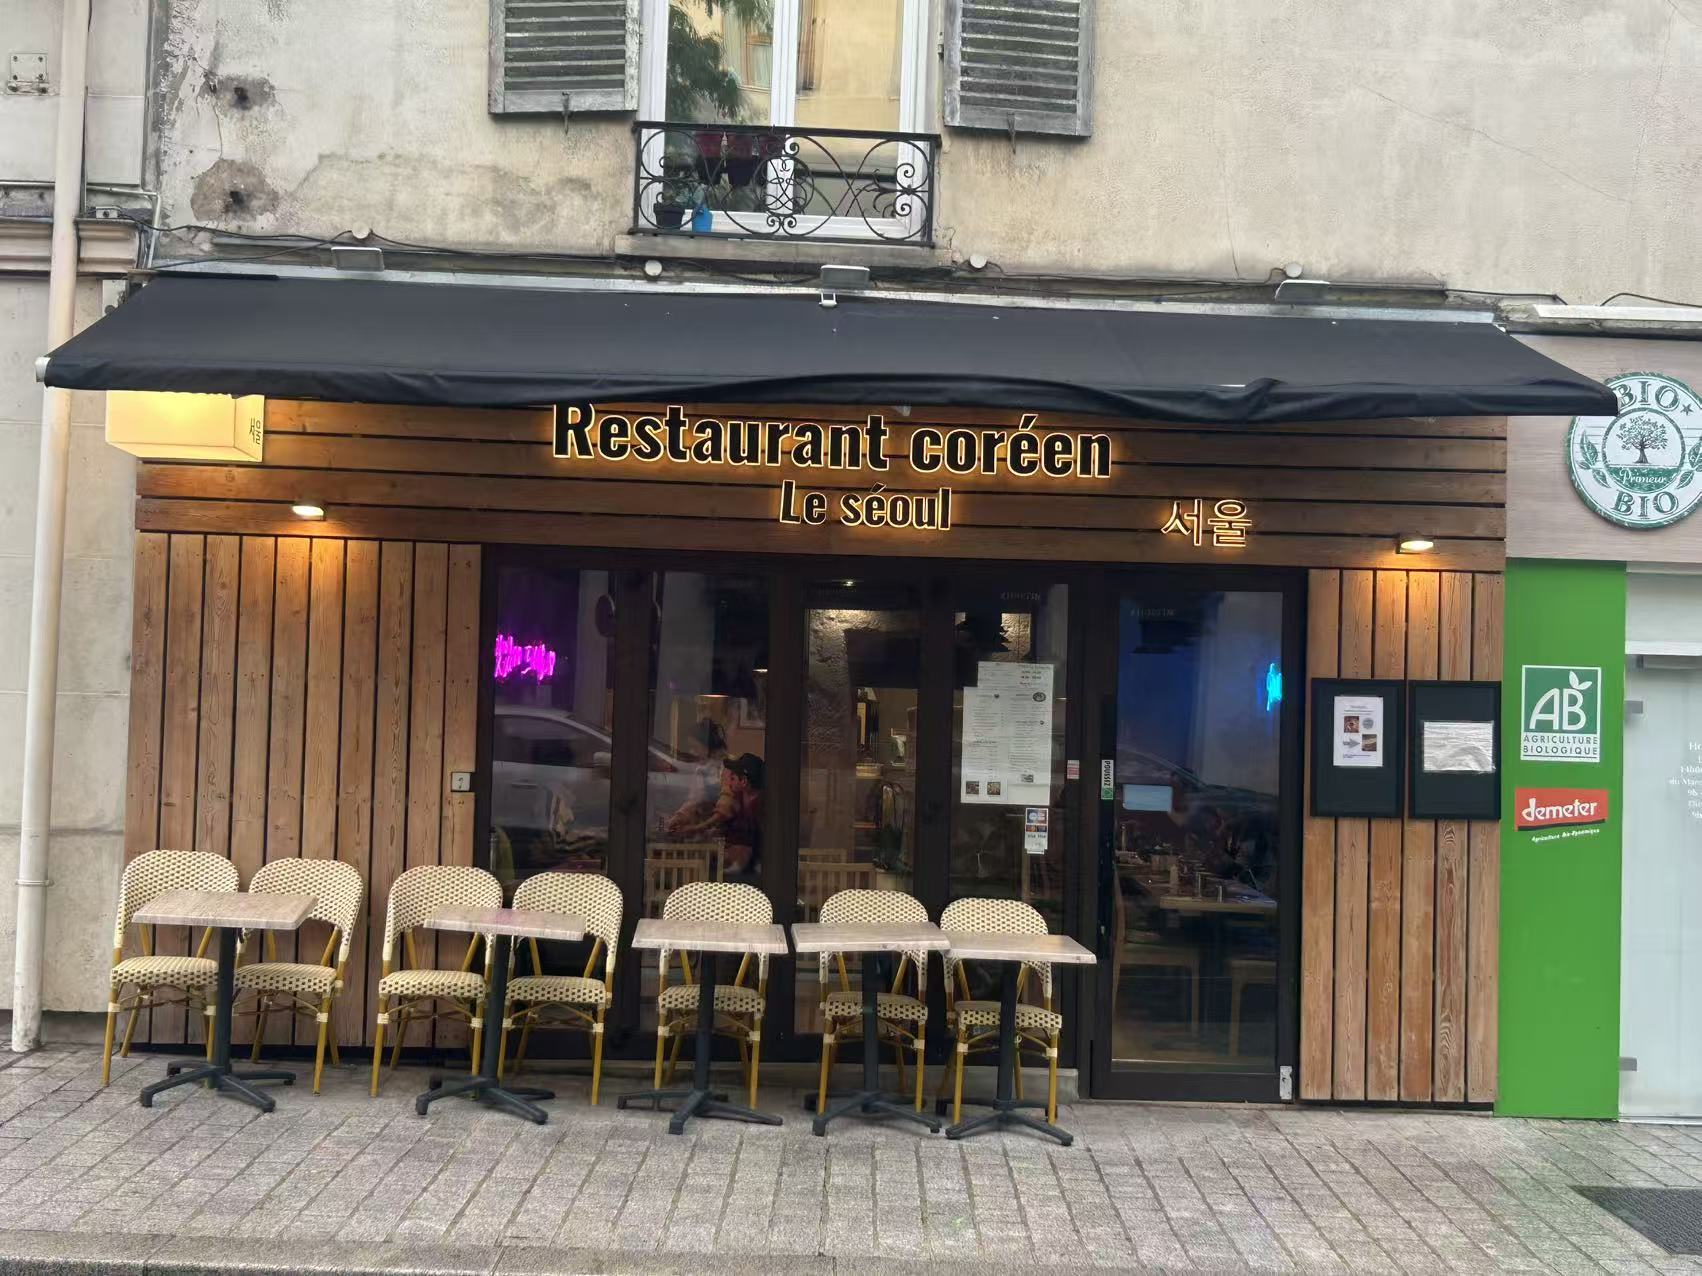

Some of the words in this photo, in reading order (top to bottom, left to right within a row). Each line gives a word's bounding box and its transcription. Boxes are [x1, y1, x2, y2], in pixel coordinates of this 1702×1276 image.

[1614, 380, 1680, 412] BIO
[553, 402, 891, 471] Restaurant
[908, 413, 1112, 479] coréen
[778, 480, 827, 525] Le
[839, 482, 953, 532] séoul
[1611, 489, 1680, 520] BIO
[1160, 497, 1253, 548] 서울
[1529, 687, 1587, 731] AB
[1523, 733, 1598, 745] AGRICULTURE
[1523, 745, 1598, 755] BIOLOGIQUE
[1103, 760, 1112, 787] POUSSEZ
[1522, 797, 1598, 822] demeter
